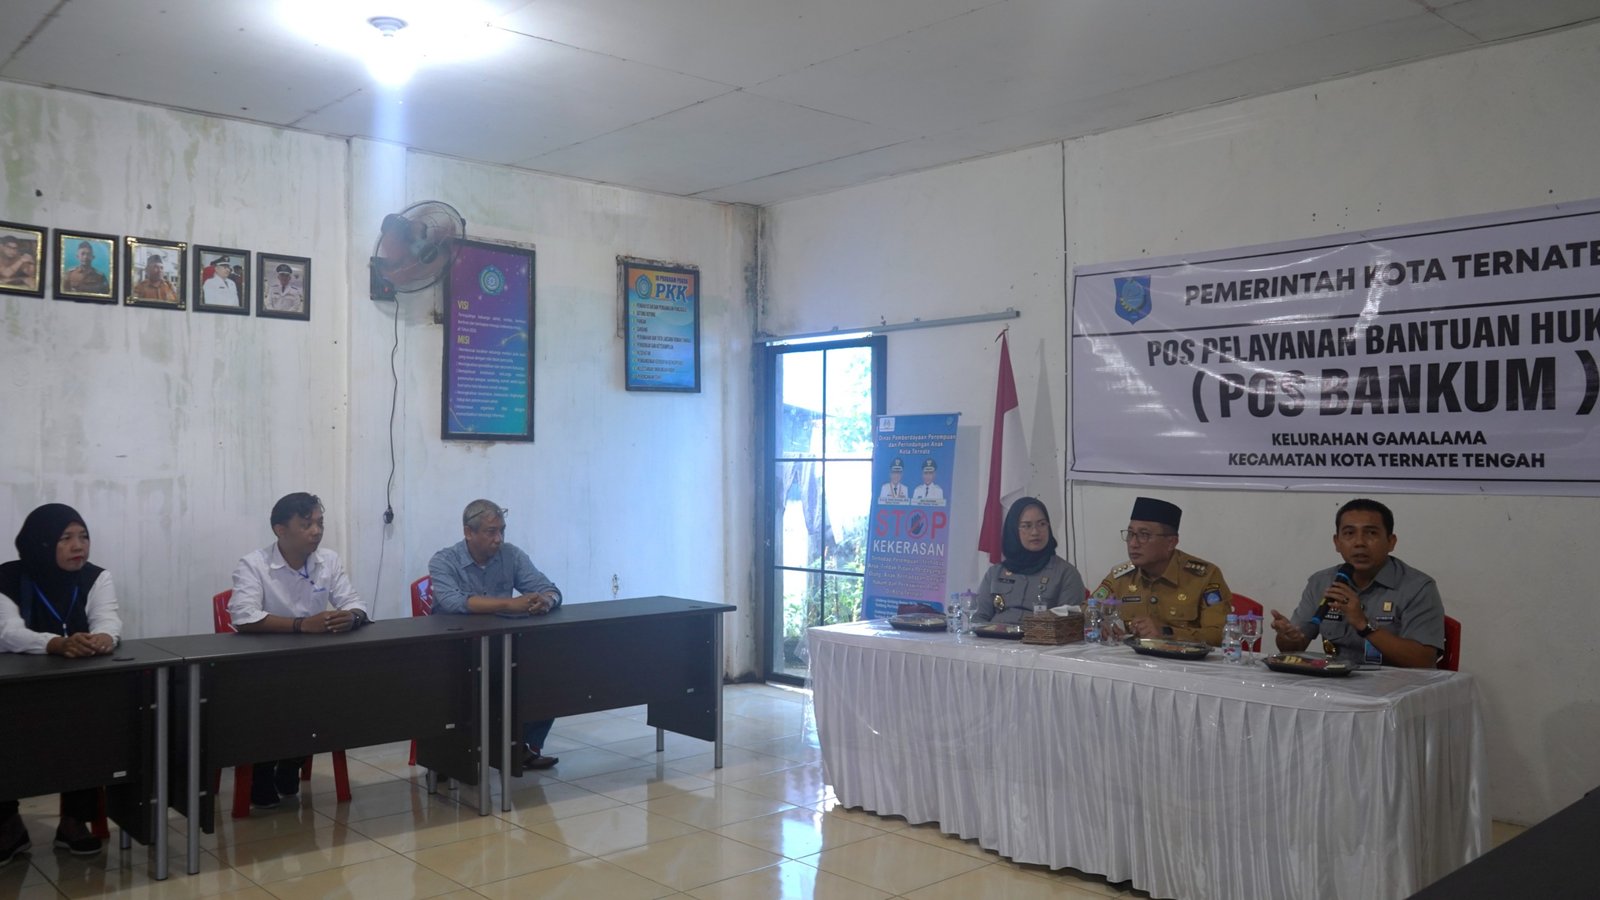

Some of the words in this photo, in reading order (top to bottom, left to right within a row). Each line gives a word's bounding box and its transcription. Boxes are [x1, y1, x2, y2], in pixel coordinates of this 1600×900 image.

[1185, 267, 1355, 306] PEMERINTAH
[1364, 258, 1446, 288] KOTA
[1452, 240, 1600, 279] TERNATE
[656, 283, 688, 303] PKK
[458, 300, 469, 310] VISI
[458, 335, 470, 345] MISI
[1147, 339, 1195, 366] POS
[1201, 327, 1357, 364] PELAYANAN
[1366, 314, 1520, 355] BANTUAN
[1271, 432, 1368, 446] KELURAHAN
[1372, 430, 1487, 446] GAMALAMA
[1228, 453, 1327, 467] KECAMATAN
[1331, 453, 1376, 467] KOTA
[1378, 453, 1459, 468] TERNATE
[1462, 453, 1546, 468] TENGAH
[876, 508, 947, 539] STOP
[873, 539, 944, 557] KEKERASAN
